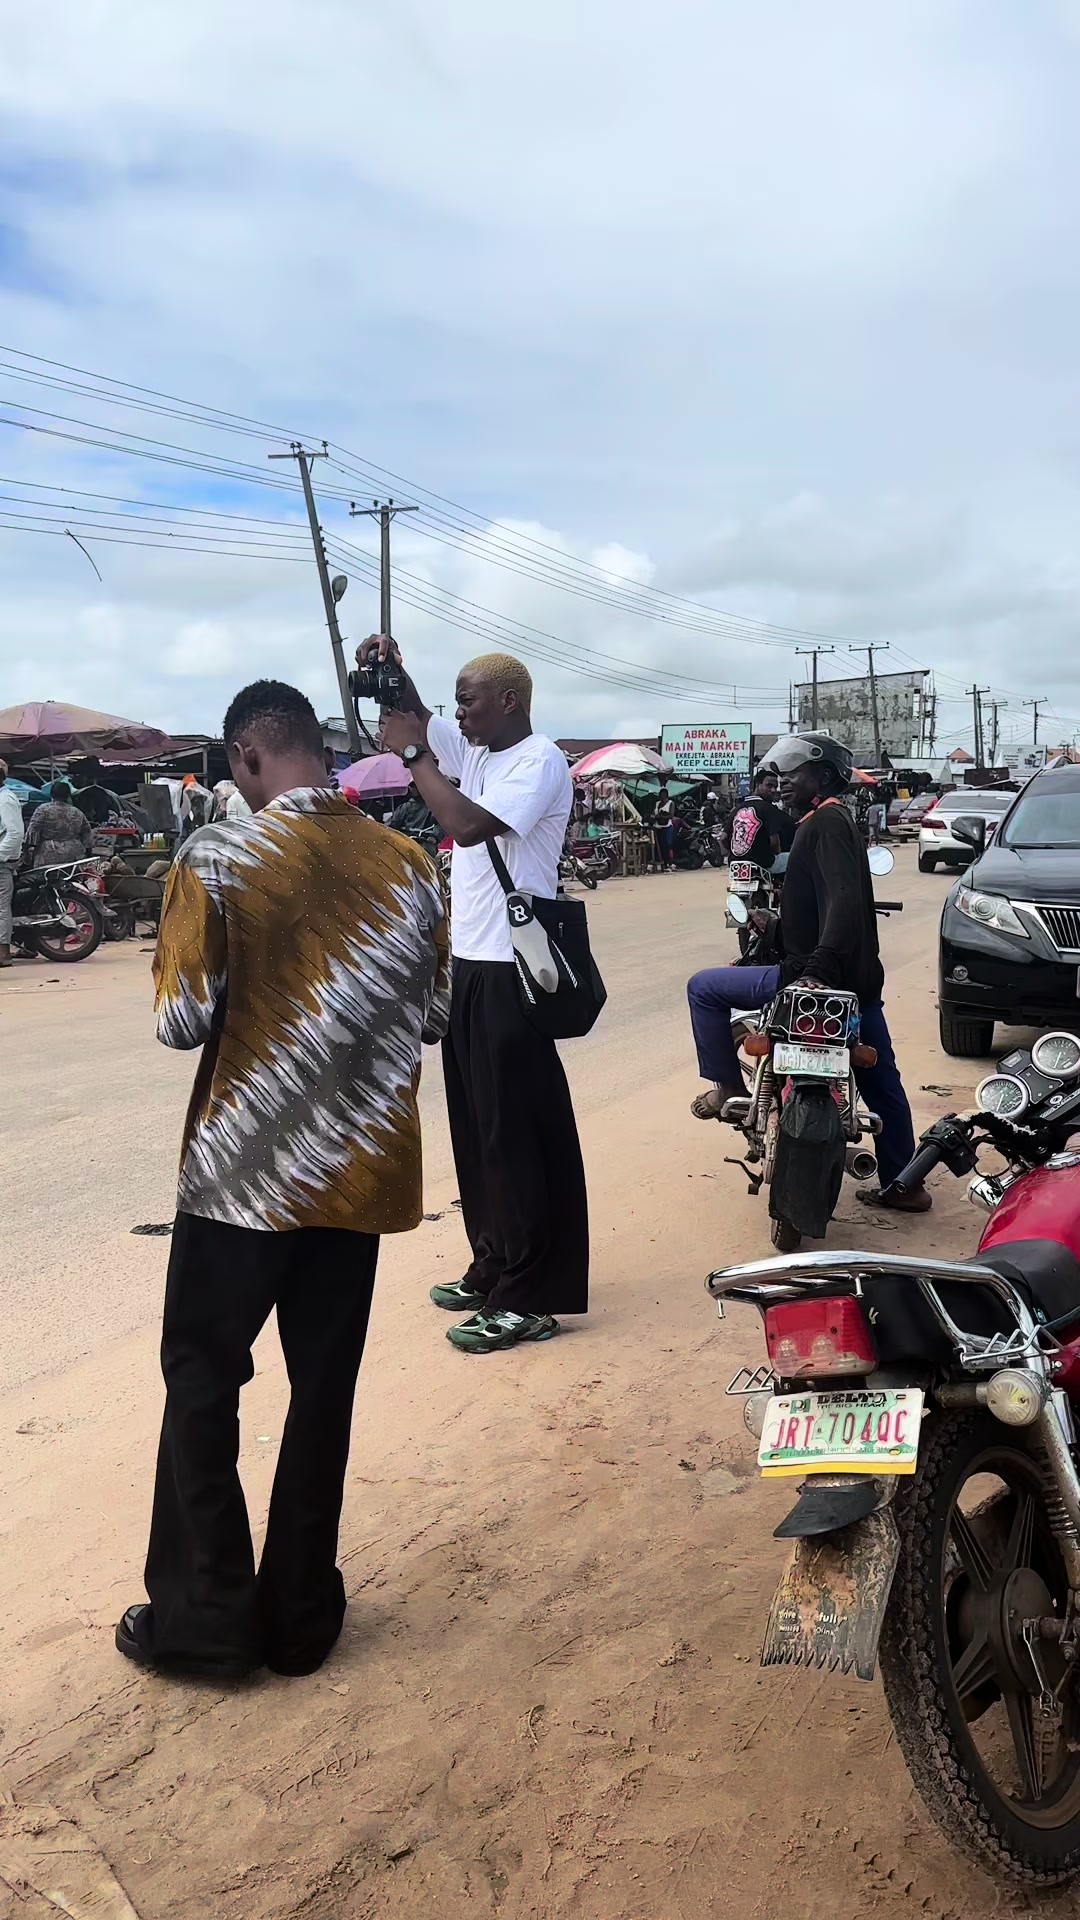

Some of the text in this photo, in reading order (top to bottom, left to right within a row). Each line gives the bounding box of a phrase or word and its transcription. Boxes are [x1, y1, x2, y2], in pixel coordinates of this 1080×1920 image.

[684, 729, 727, 739] ABRAKA
[665, 741, 747, 752] MAIN MARKET
[702, 759, 733, 767] CLEAN
[816, 1392, 887, 1405] DELTA
